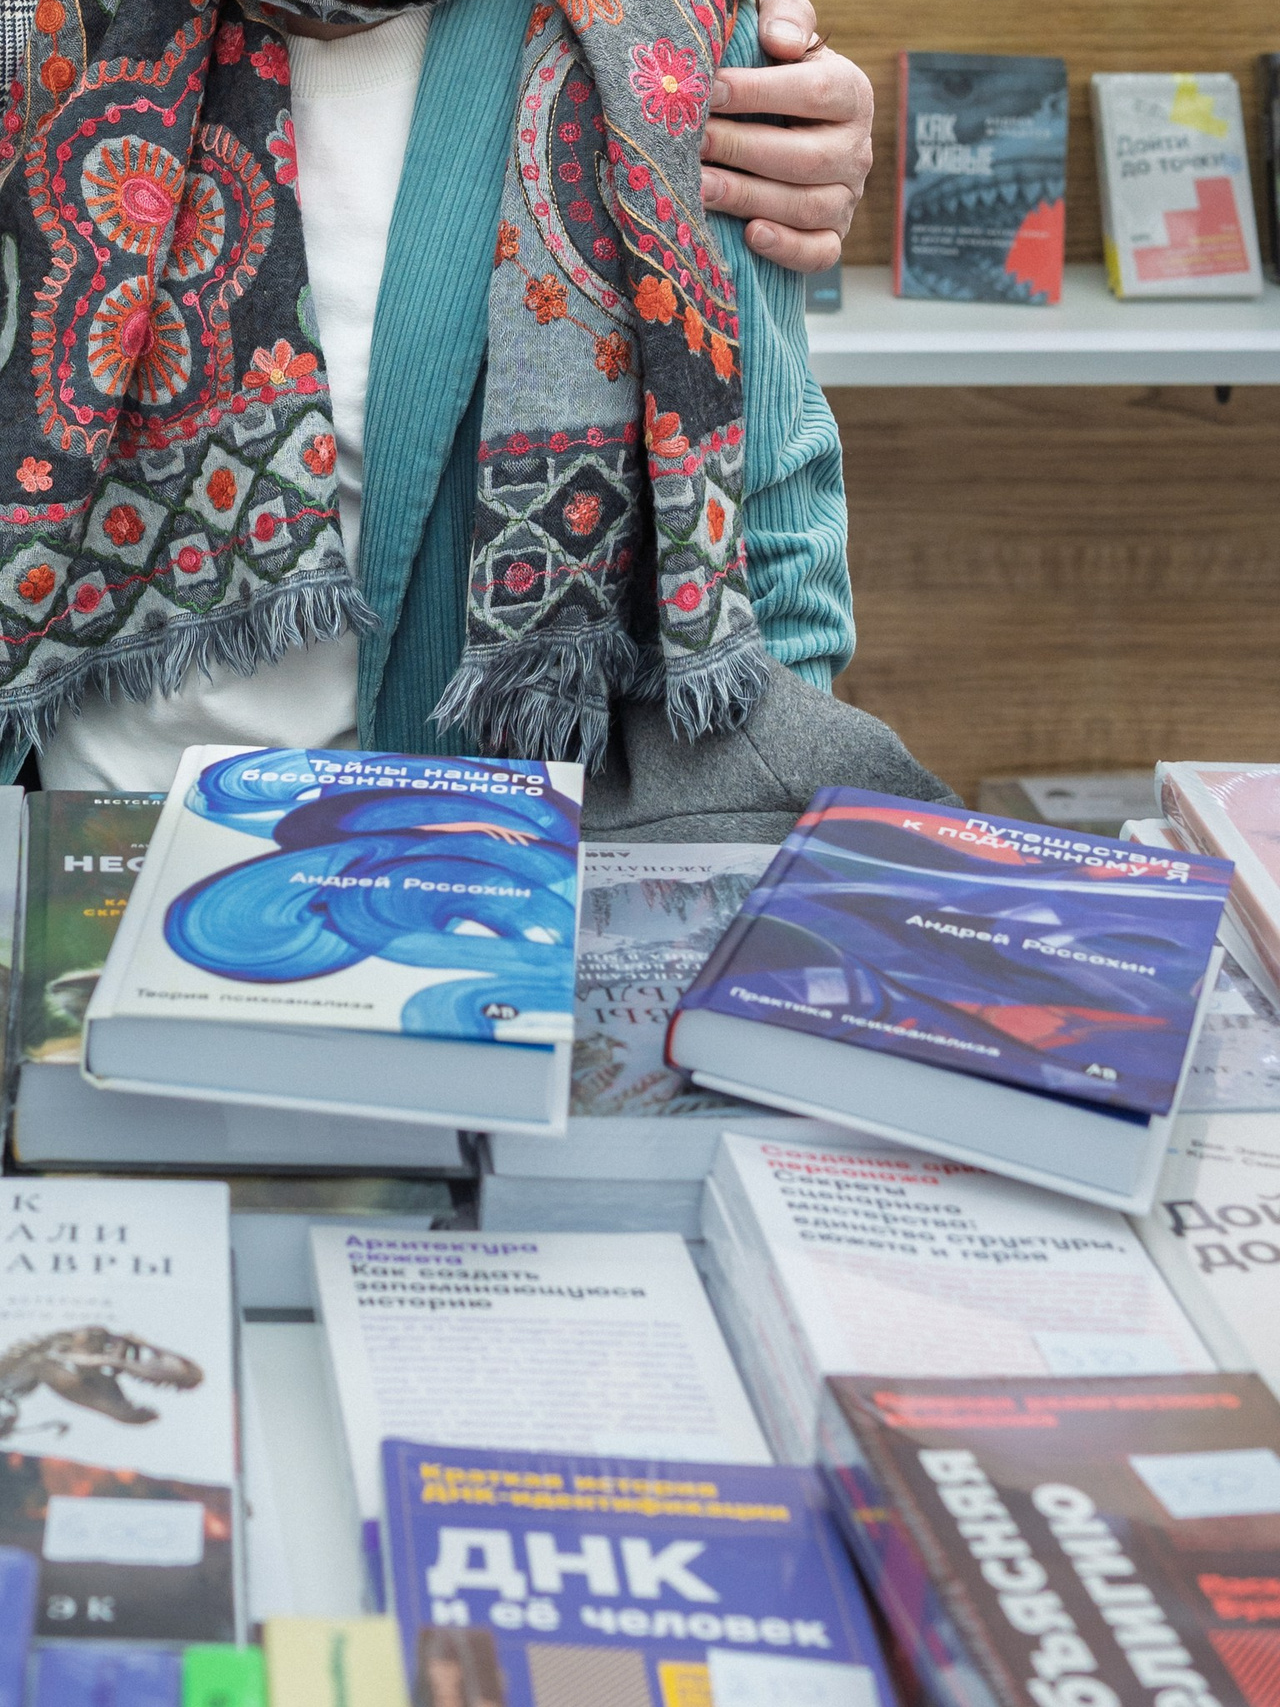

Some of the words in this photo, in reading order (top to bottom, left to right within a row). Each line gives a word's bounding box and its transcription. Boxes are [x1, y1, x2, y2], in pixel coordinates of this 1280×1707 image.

[917, 114, 957, 142] КАК
[1117, 134, 1189, 157] Дойти
[915, 145, 994, 175] ЖИВЫЕ
[1121, 161, 1150, 178] до
[241, 769, 545, 797] бессознательного
[310, 760, 407, 776] Тайны
[424, 768, 545, 785] нашего
[938, 826, 1149, 877] подлинному
[1165, 869, 1190, 884] Я
[965, 818, 1191, 872] Путешествие
[289, 872, 391, 890] Андрей
[404, 877, 531, 899] Россохин
[83, 908, 126, 917] СКР
[905, 914, 1010, 946] Андрей
[1022, 938, 1156, 976] Россохин
[136, 987, 210, 1003] Теория
[220, 993, 375, 1010] психоанализа
[729, 985, 833, 1020] Практика
[841, 1012, 1001, 1058] психоанализа
[761, 1144, 911, 1171] Создание
[767, 1160, 940, 1186] персонажа
[774, 1169, 907, 1196] Секреты
[780, 1186, 962, 1215] сценарного
[792, 1216, 935, 1242] единство
[345, 1235, 538, 1255] Архитектура
[348, 1251, 463, 1265] сюжета
[798, 1230, 918, 1255] сюжета
[930, 1248, 949, 1258] и
[960, 1250, 1050, 1264] героя
[351, 1264, 406, 1279] Как
[419, 1268, 539, 1281] создать
[353, 1280, 647, 1300] запоминающуюся
[357, 1296, 493, 1312] историю
[419, 1462, 563, 1489] Краткая
[573, 1475, 718, 1499] история
[427, 1526, 722, 1604] ДНК
[431, 1599, 470, 1629] и
[580, 1605, 833, 1650] человек
